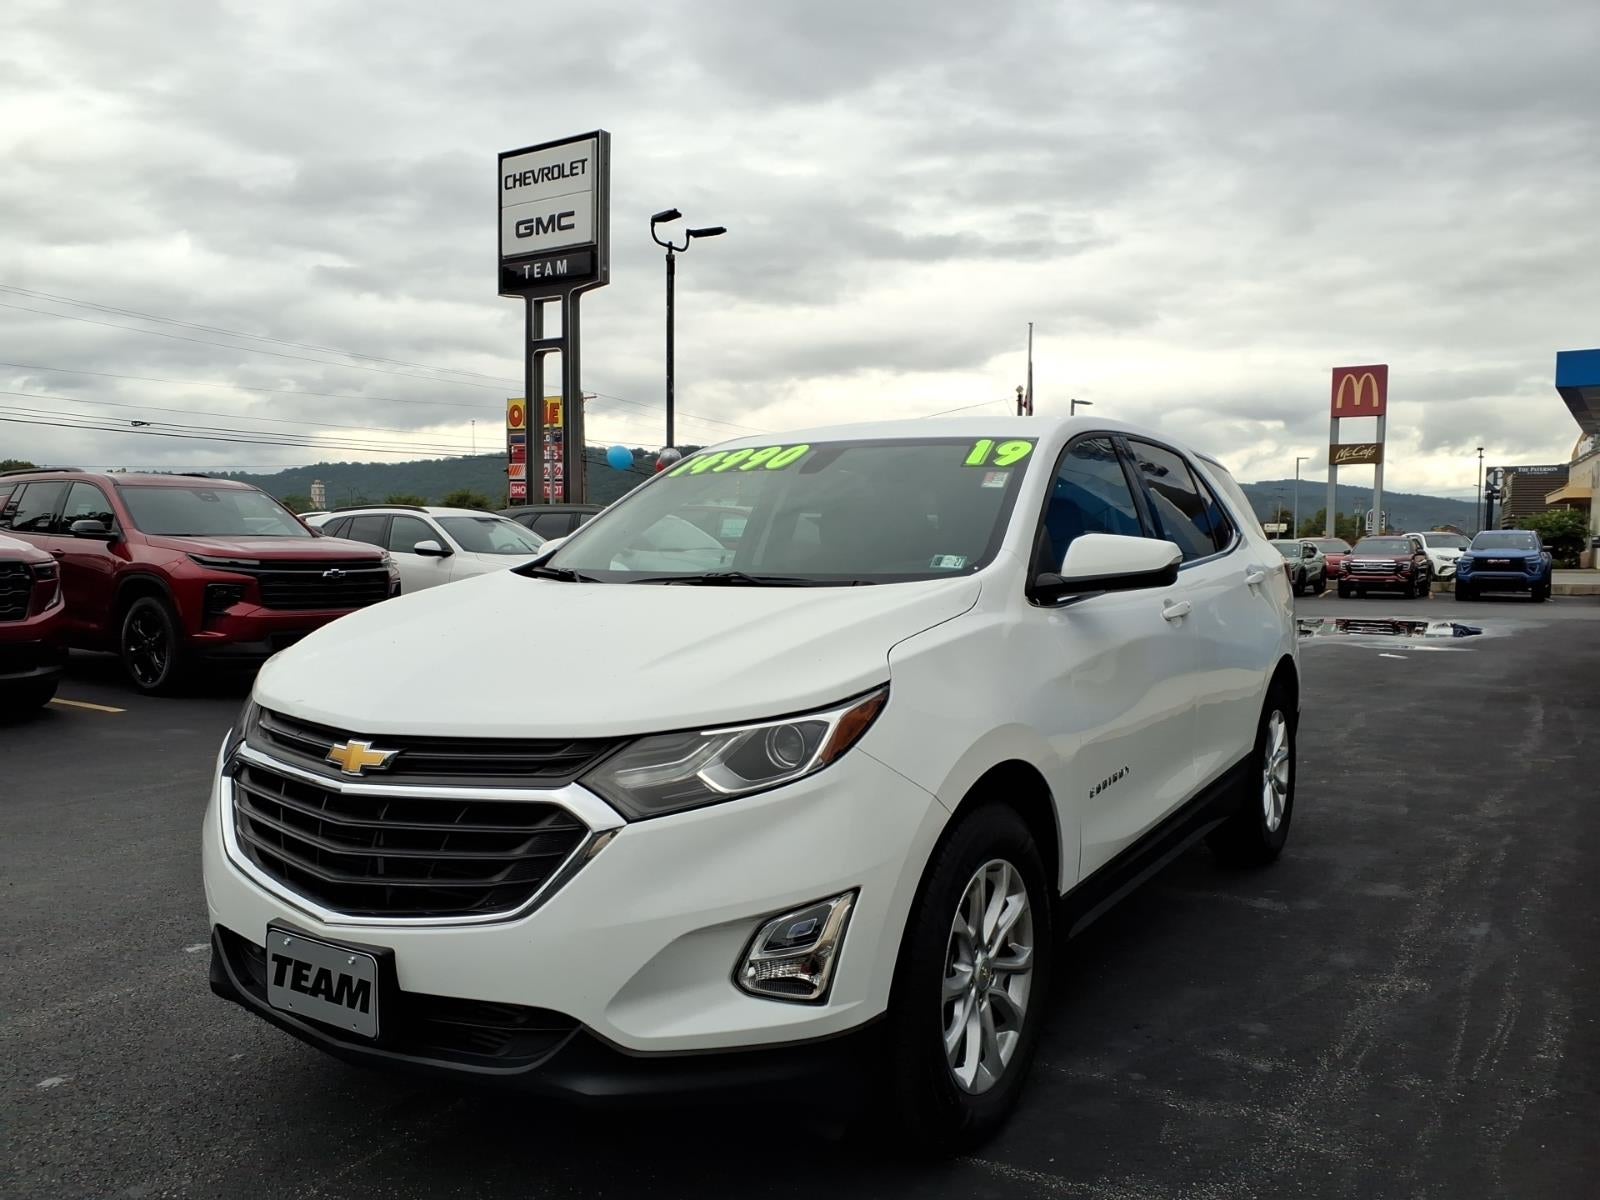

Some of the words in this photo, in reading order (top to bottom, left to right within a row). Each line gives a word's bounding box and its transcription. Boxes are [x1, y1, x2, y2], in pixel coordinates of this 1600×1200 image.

[504, 158, 588, 190] CHEVROLET
[515, 210, 575, 238] GMC
[523, 259, 567, 279] TEAM
[964, 439, 1033, 466] 19
[271, 953, 371, 1014] TEAM
